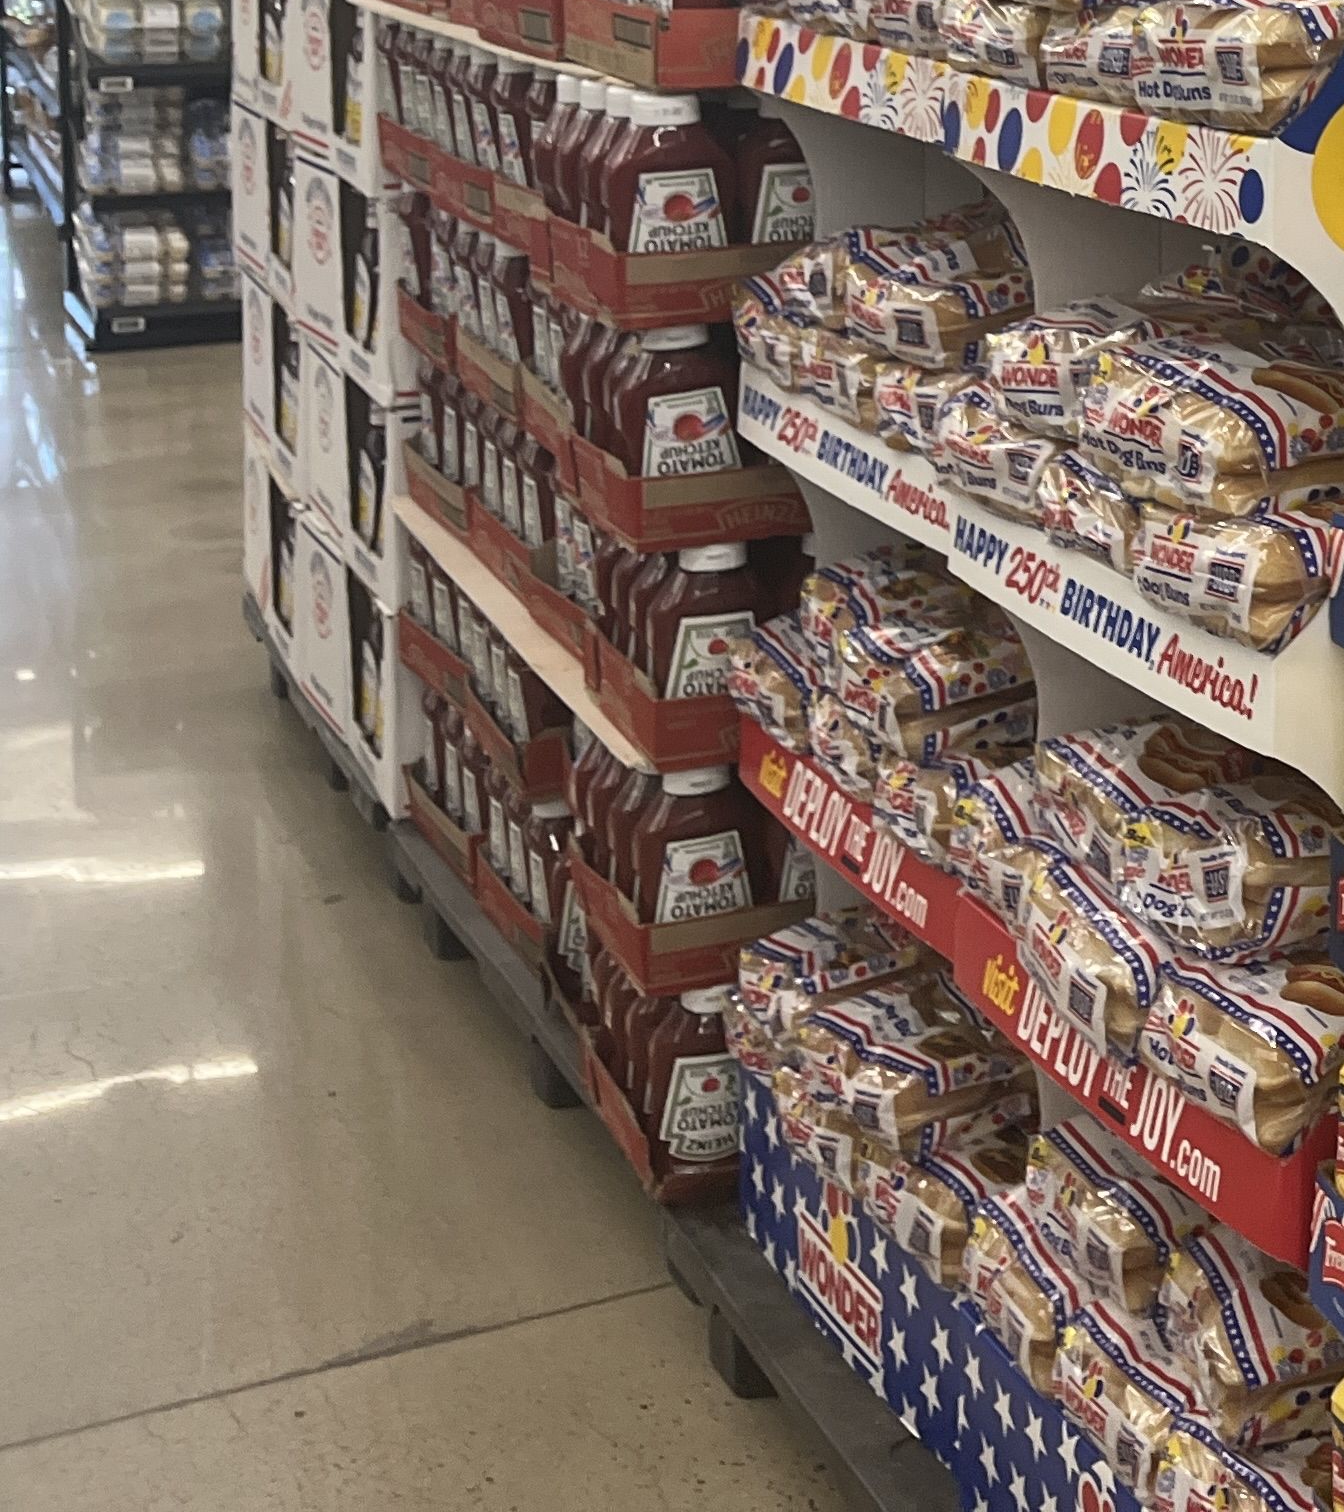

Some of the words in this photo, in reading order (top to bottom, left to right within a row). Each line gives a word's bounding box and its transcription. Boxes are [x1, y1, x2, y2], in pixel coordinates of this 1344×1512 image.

[742, 387, 780, 430] HAPPY
[777, 401, 819, 457] 250th
[952, 514, 1008, 576] HAPPY
[1004, 548, 1060, 607] 250th
[1060, 578, 1160, 671] BIRTHDAY,
[1157, 634, 1260, 721] America!
[782, 762, 850, 857] DEPLOY
[845, 810, 872, 865] THE
[863, 838, 929, 931] JOY.com
[982, 953, 1020, 1017] Visit
[1017, 993, 1103, 1100] DEPLOY
[1100, 1061, 1132, 1110] THE
[1128, 1078, 1222, 1204] JOY.com
[799, 1228, 882, 1357] WONDER
